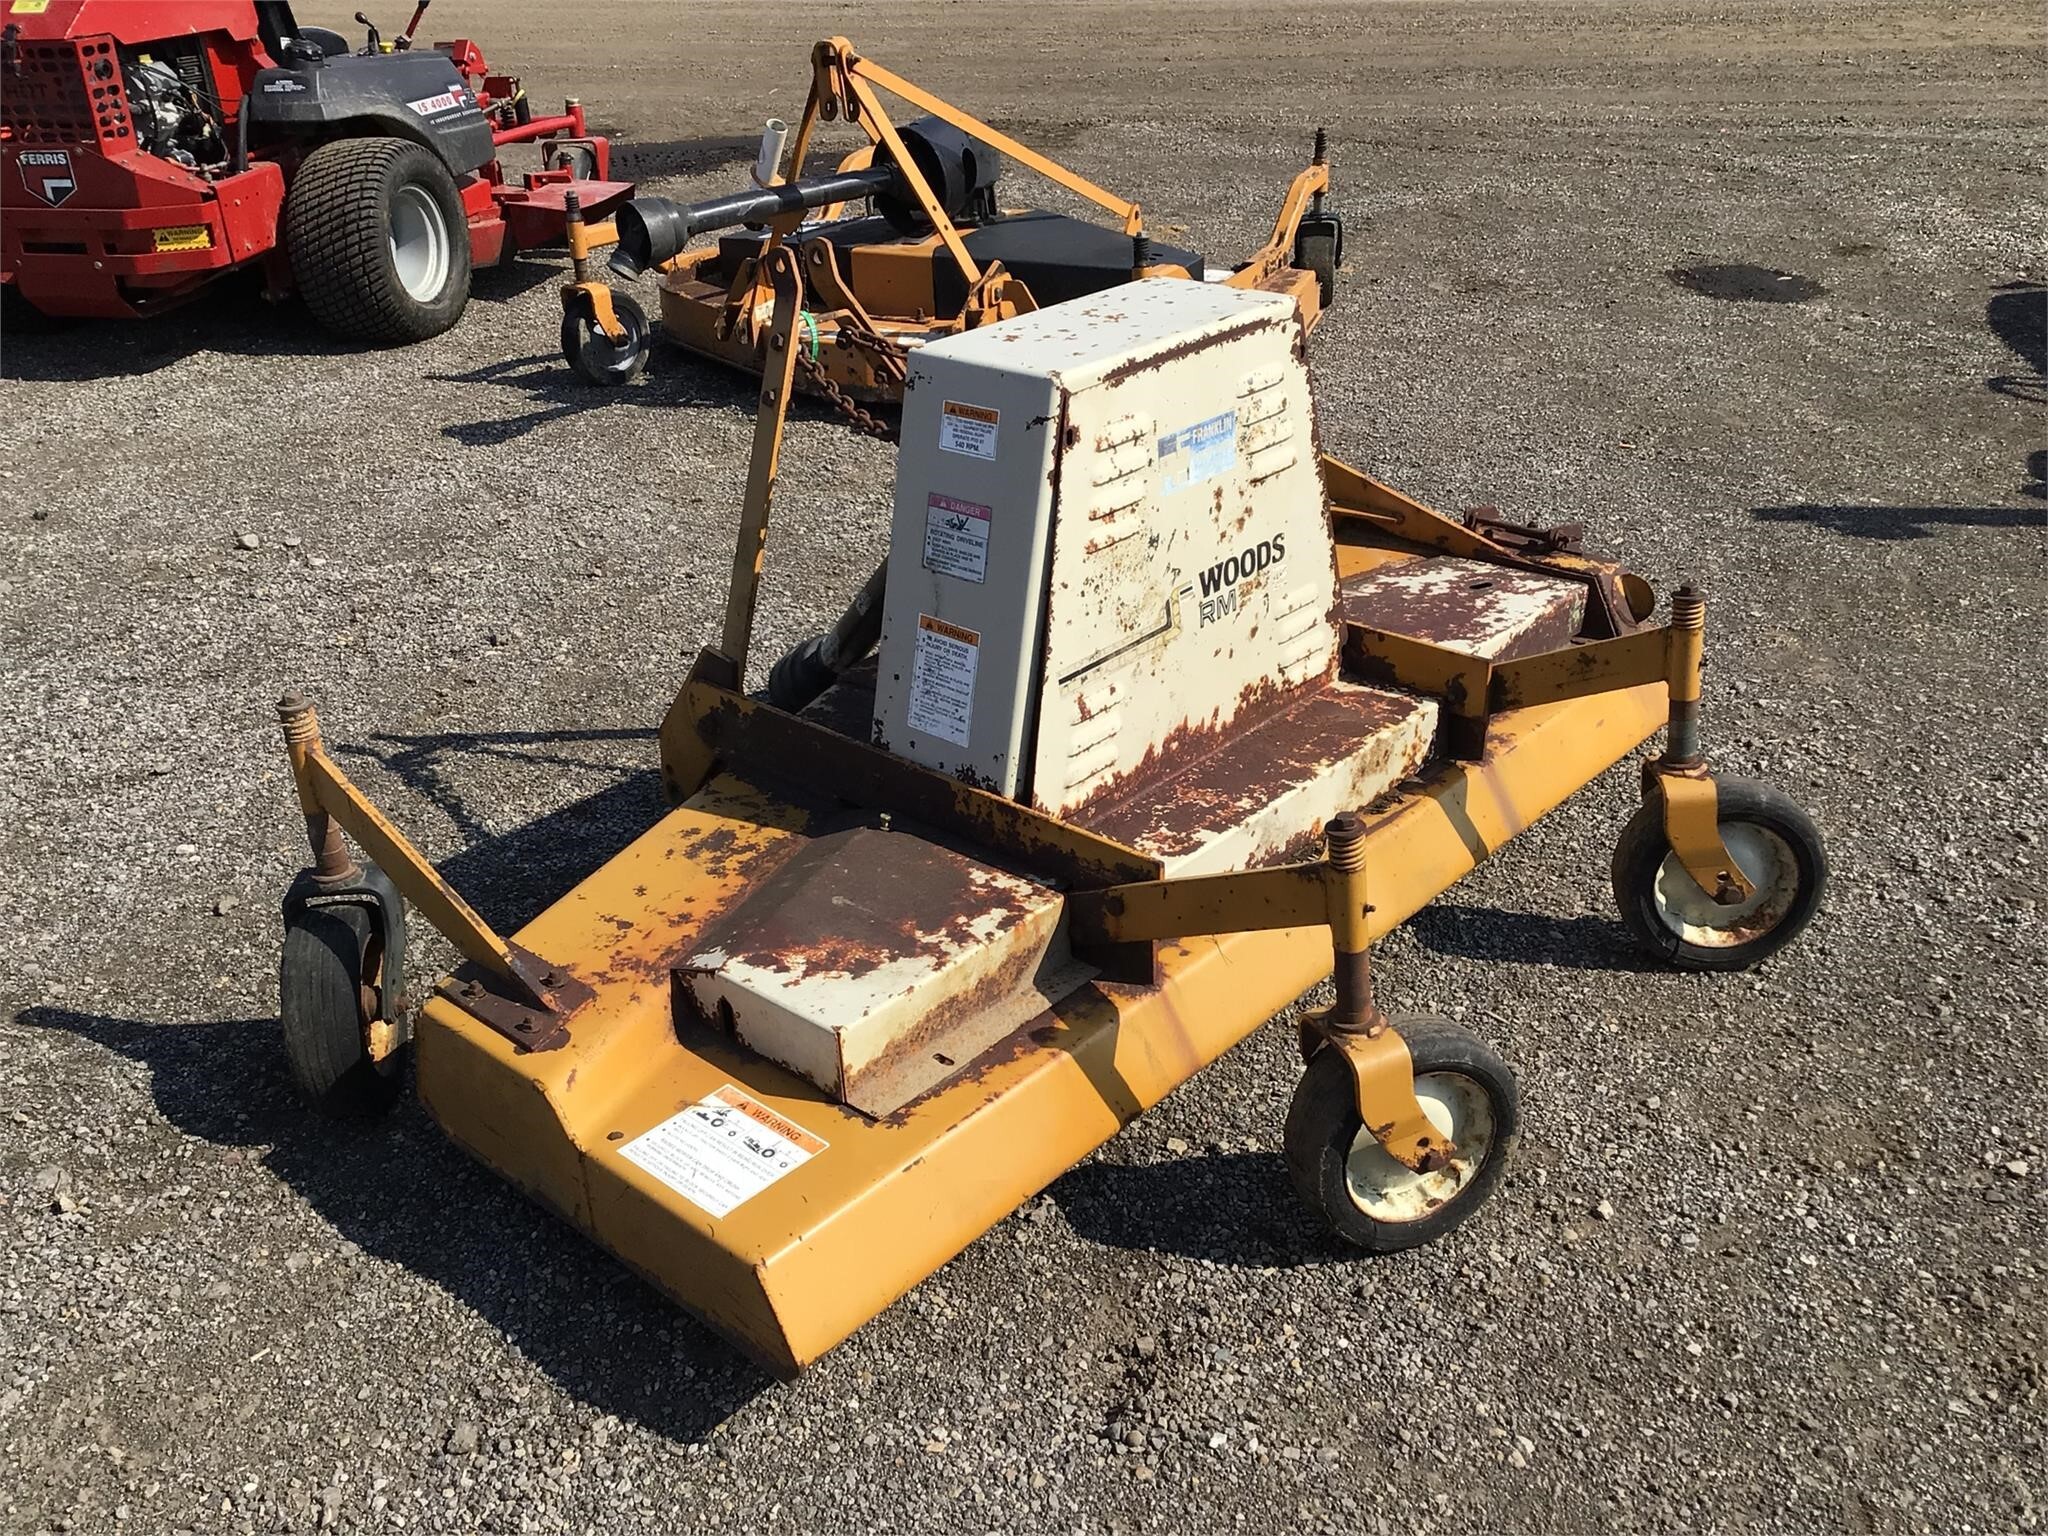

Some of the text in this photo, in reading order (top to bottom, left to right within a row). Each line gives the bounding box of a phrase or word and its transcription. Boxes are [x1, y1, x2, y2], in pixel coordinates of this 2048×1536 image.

[417, 95, 453, 113] IS 4000
[21, 153, 67, 165] FERRIS
[958, 406, 993, 421] WARNING
[1192, 415, 1233, 445] FRANKLIN
[955, 440, 965, 449] 540
[950, 501, 981, 516] DANGER
[930, 528, 984, 548] ROTATING DRIVELINE
[1198, 532, 1286, 599] WOODS
[937, 623, 973, 643] WARNING
[948, 642, 969, 654] SERIOUS
[752, 1108, 801, 1141] WARNING
